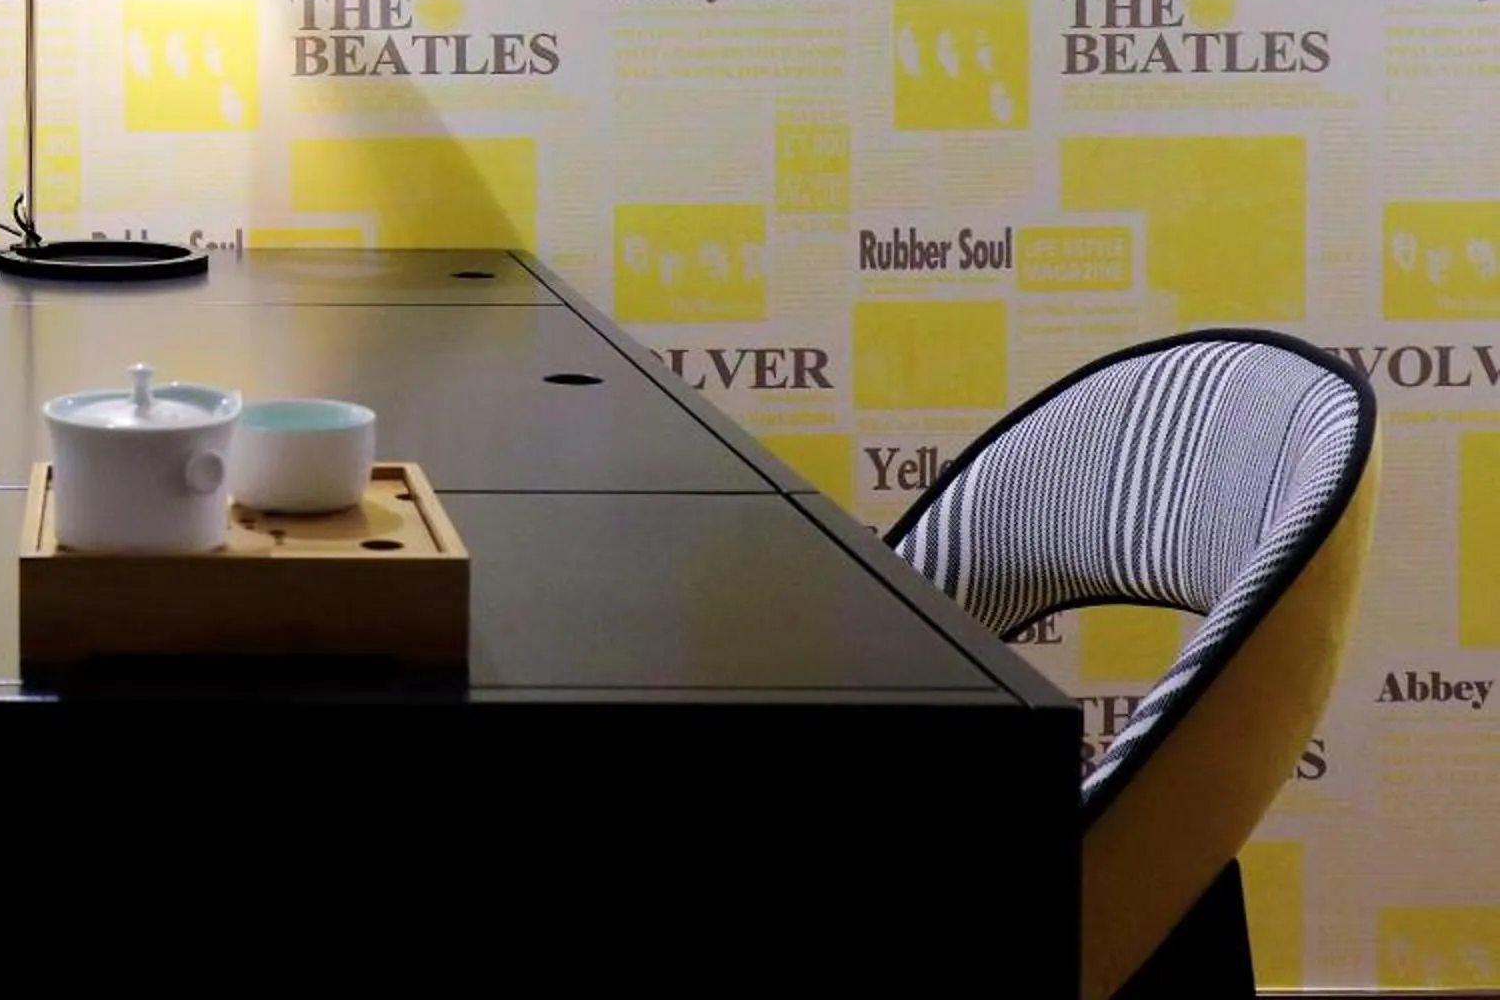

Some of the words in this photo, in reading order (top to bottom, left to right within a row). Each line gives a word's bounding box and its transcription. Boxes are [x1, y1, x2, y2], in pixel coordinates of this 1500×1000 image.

[292, 33, 560, 76] BEATLES
[1061, 31, 1330, 74] BEATLES
[860, 227, 952, 270] Rubber
[958, 226, 1012, 270] Soul
[650, 348, 834, 389] LVER
[863, 445, 954, 491] Yell
[1376, 671, 1493, 709] Abbey
